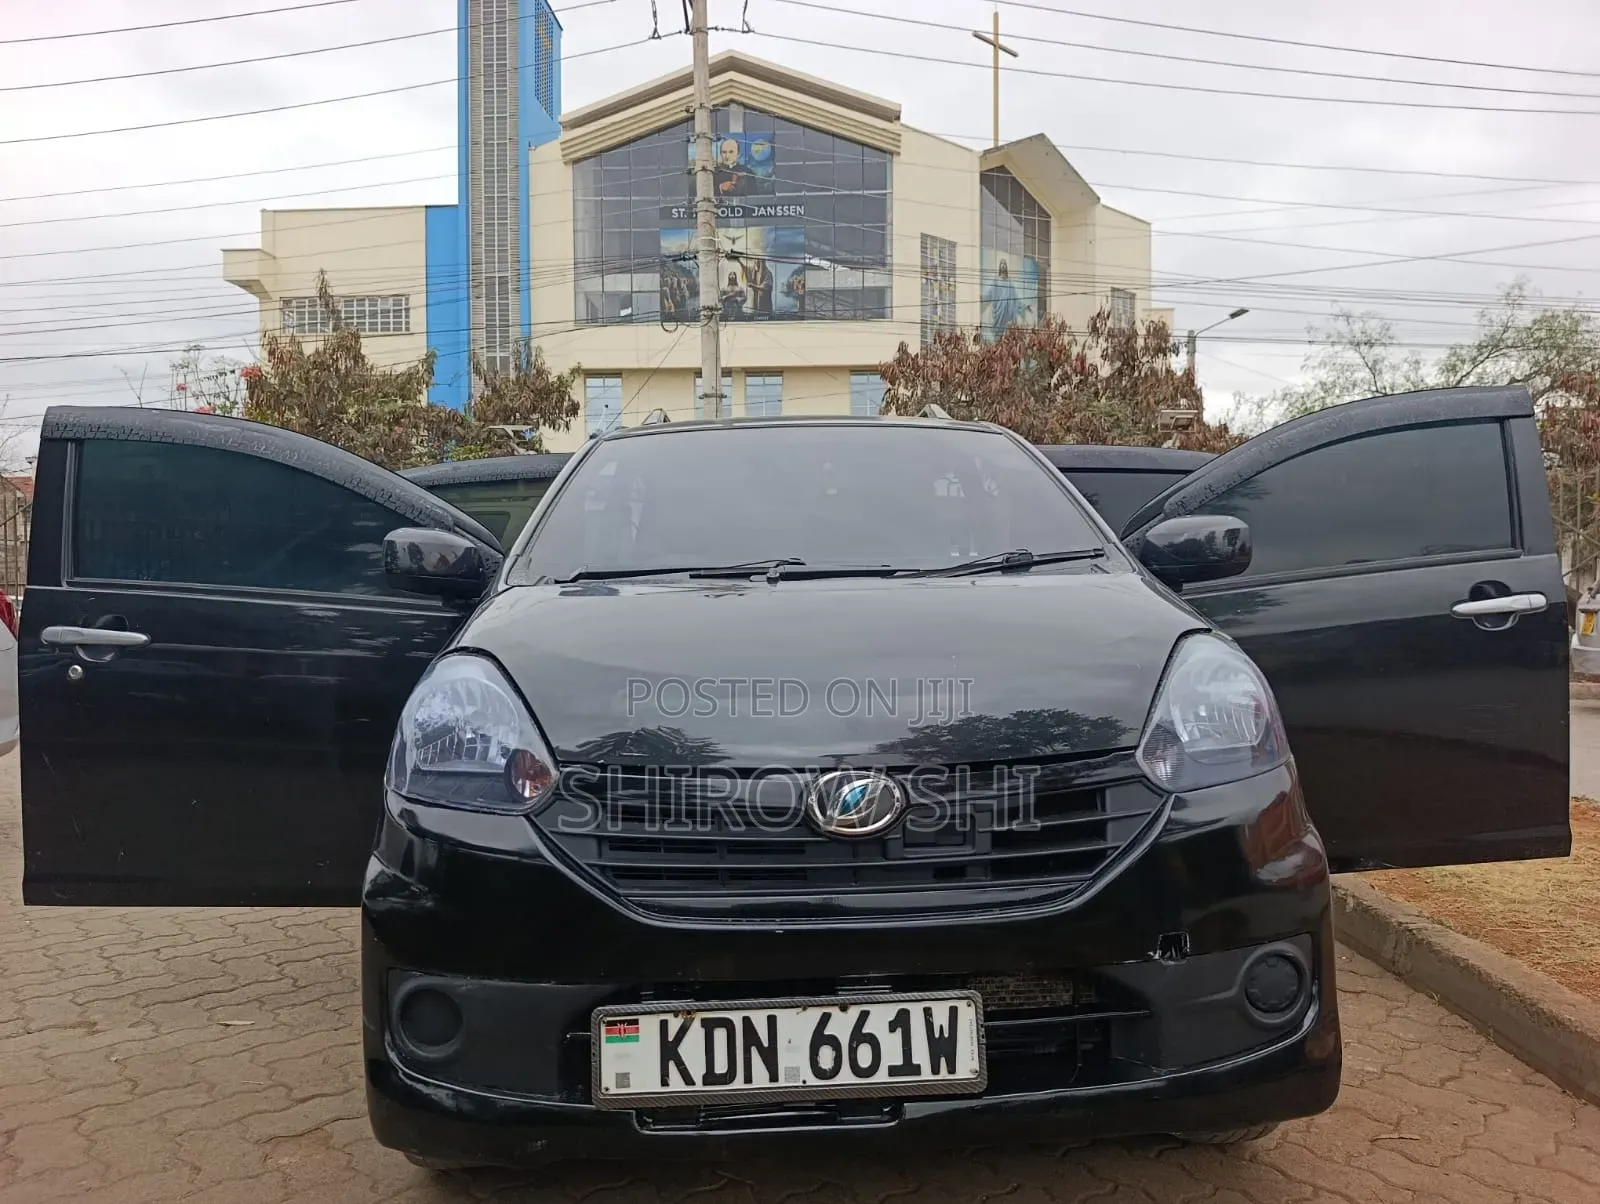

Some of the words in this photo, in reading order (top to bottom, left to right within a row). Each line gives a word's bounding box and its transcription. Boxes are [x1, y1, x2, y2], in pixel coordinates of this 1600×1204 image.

[671, 207, 687, 218] ST.
[752, 205, 805, 217] JANSSEN
[659, 1014, 779, 1087] KDN
[809, 1005, 958, 1081] 661W
